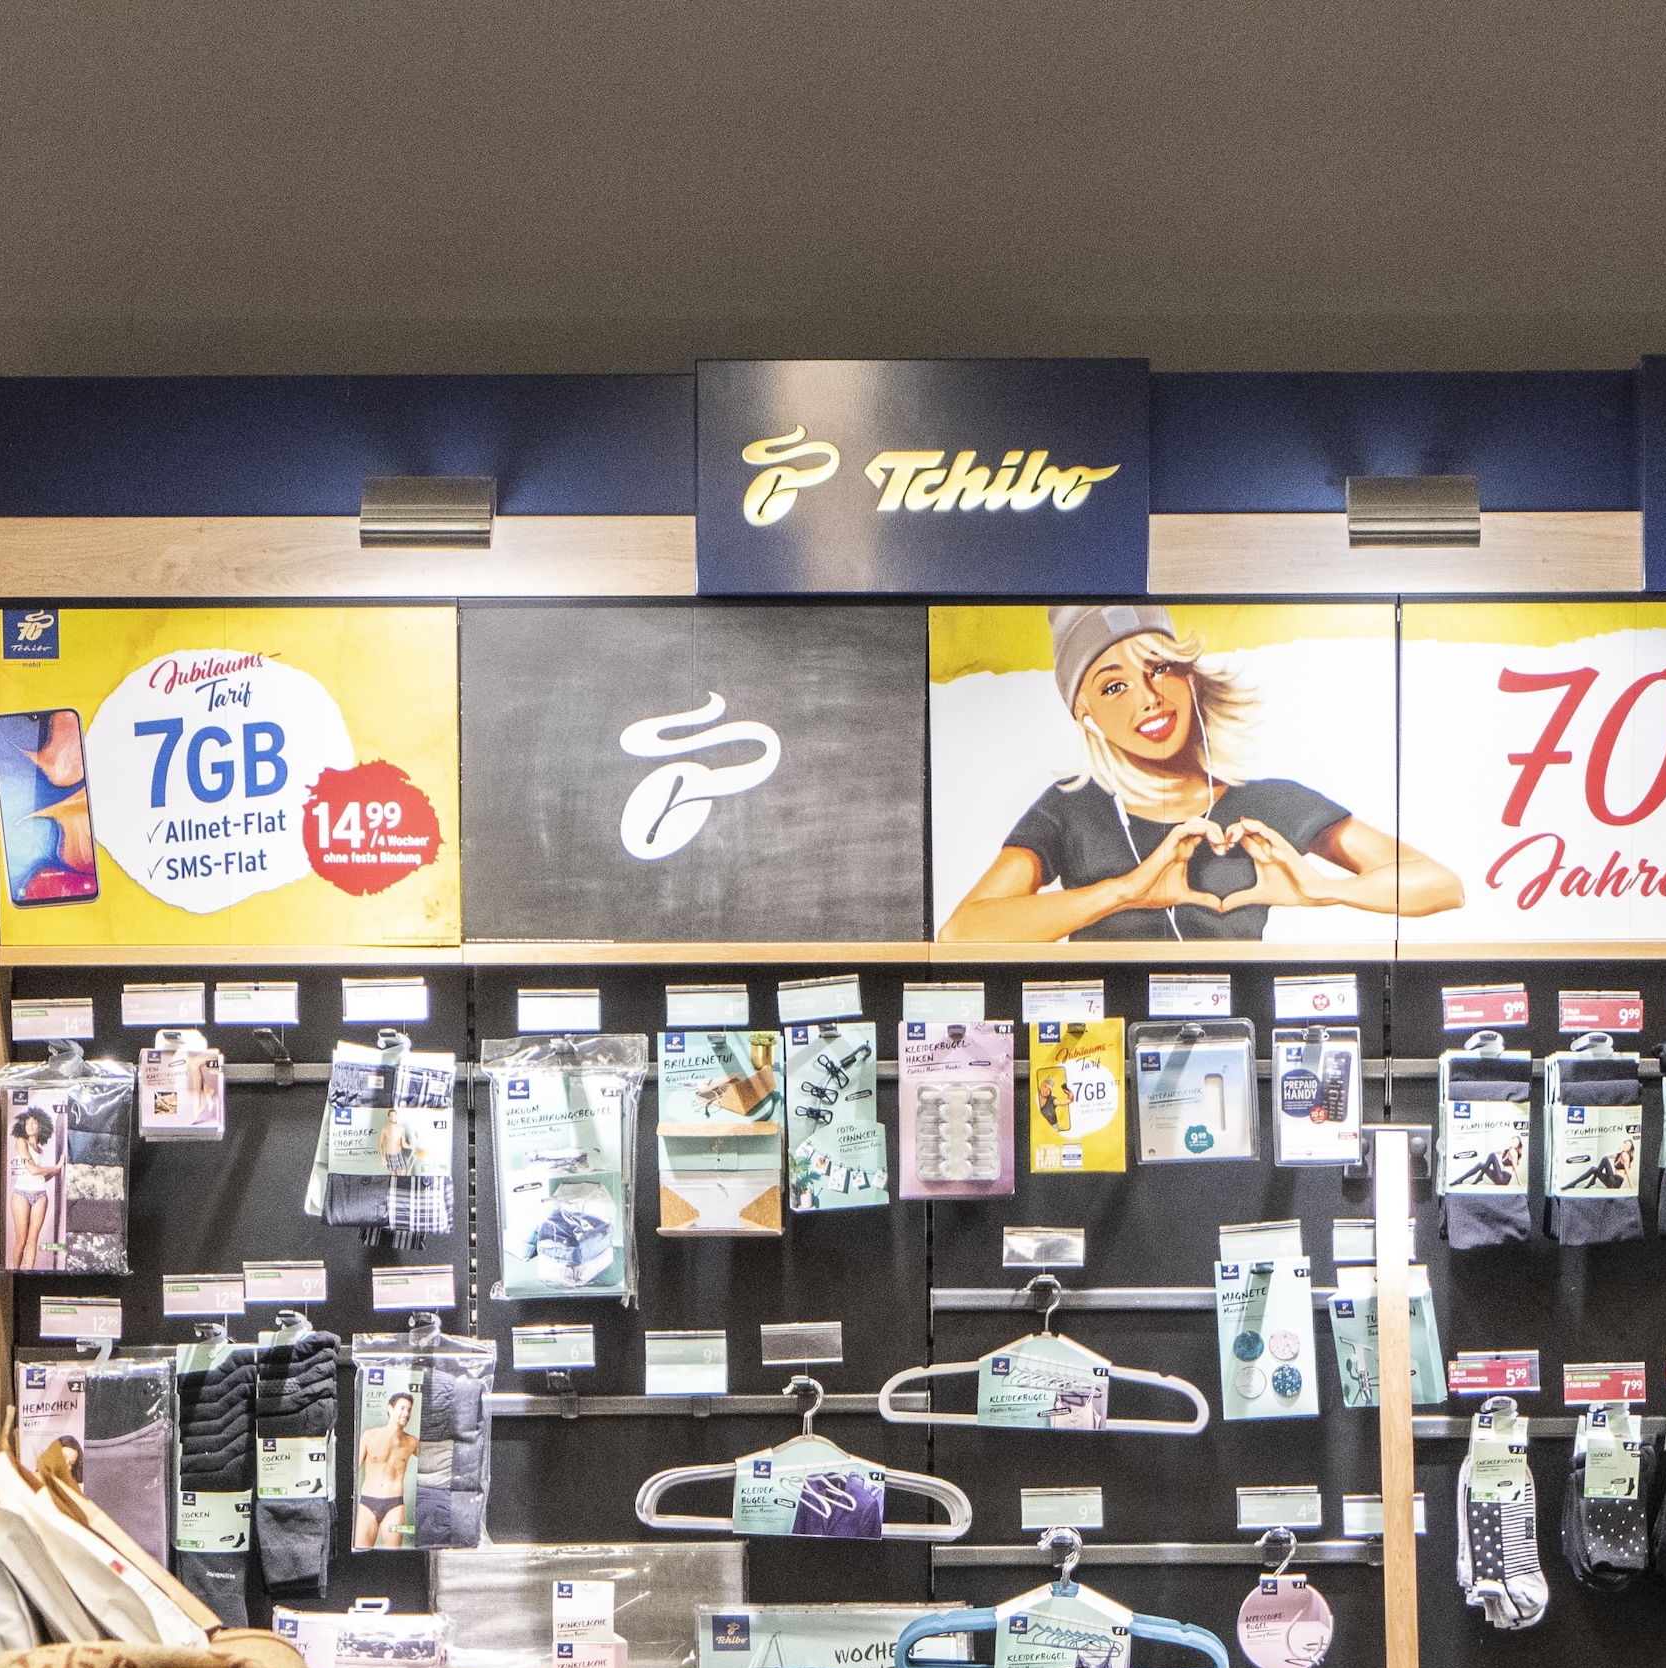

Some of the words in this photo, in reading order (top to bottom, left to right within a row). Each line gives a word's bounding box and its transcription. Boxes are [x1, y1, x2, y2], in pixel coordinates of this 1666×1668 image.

[864, 447, 1121, 513] Tchibo
[10, 644, 53, 653] Tchibo
[21, 661, 42, 669] mobil
[195, 677, 253, 713] Tarif
[133, 716, 289, 808] 7GB
[164, 808, 287, 845] Allnet-Flat
[165, 848, 268, 881] SMS-Flat
[323, 852, 348, 865] ohne
[350, 852, 377, 865] feste
[379, 851, 422, 867] Bindung
[663, 1053, 733, 1070] BRILLENETUI
[906, 1054, 934, 1064] HAKEN
[1072, 1081, 1107, 1102] 7GB
[1283, 1079, 1318, 1090] PREPAID
[1283, 1089, 1318, 1100] HANDY
[836, 1125, 858, 1134] FOTO-
[1221, 1286, 1268, 1303] MAGNETE
[22, 1398, 78, 1414] HEMDCHEN
[740, 1486, 777, 1495] KLEIDER-
[715, 1634, 749, 1645] Tchibo
[834, 1641, 924, 1665] WOCHE-
